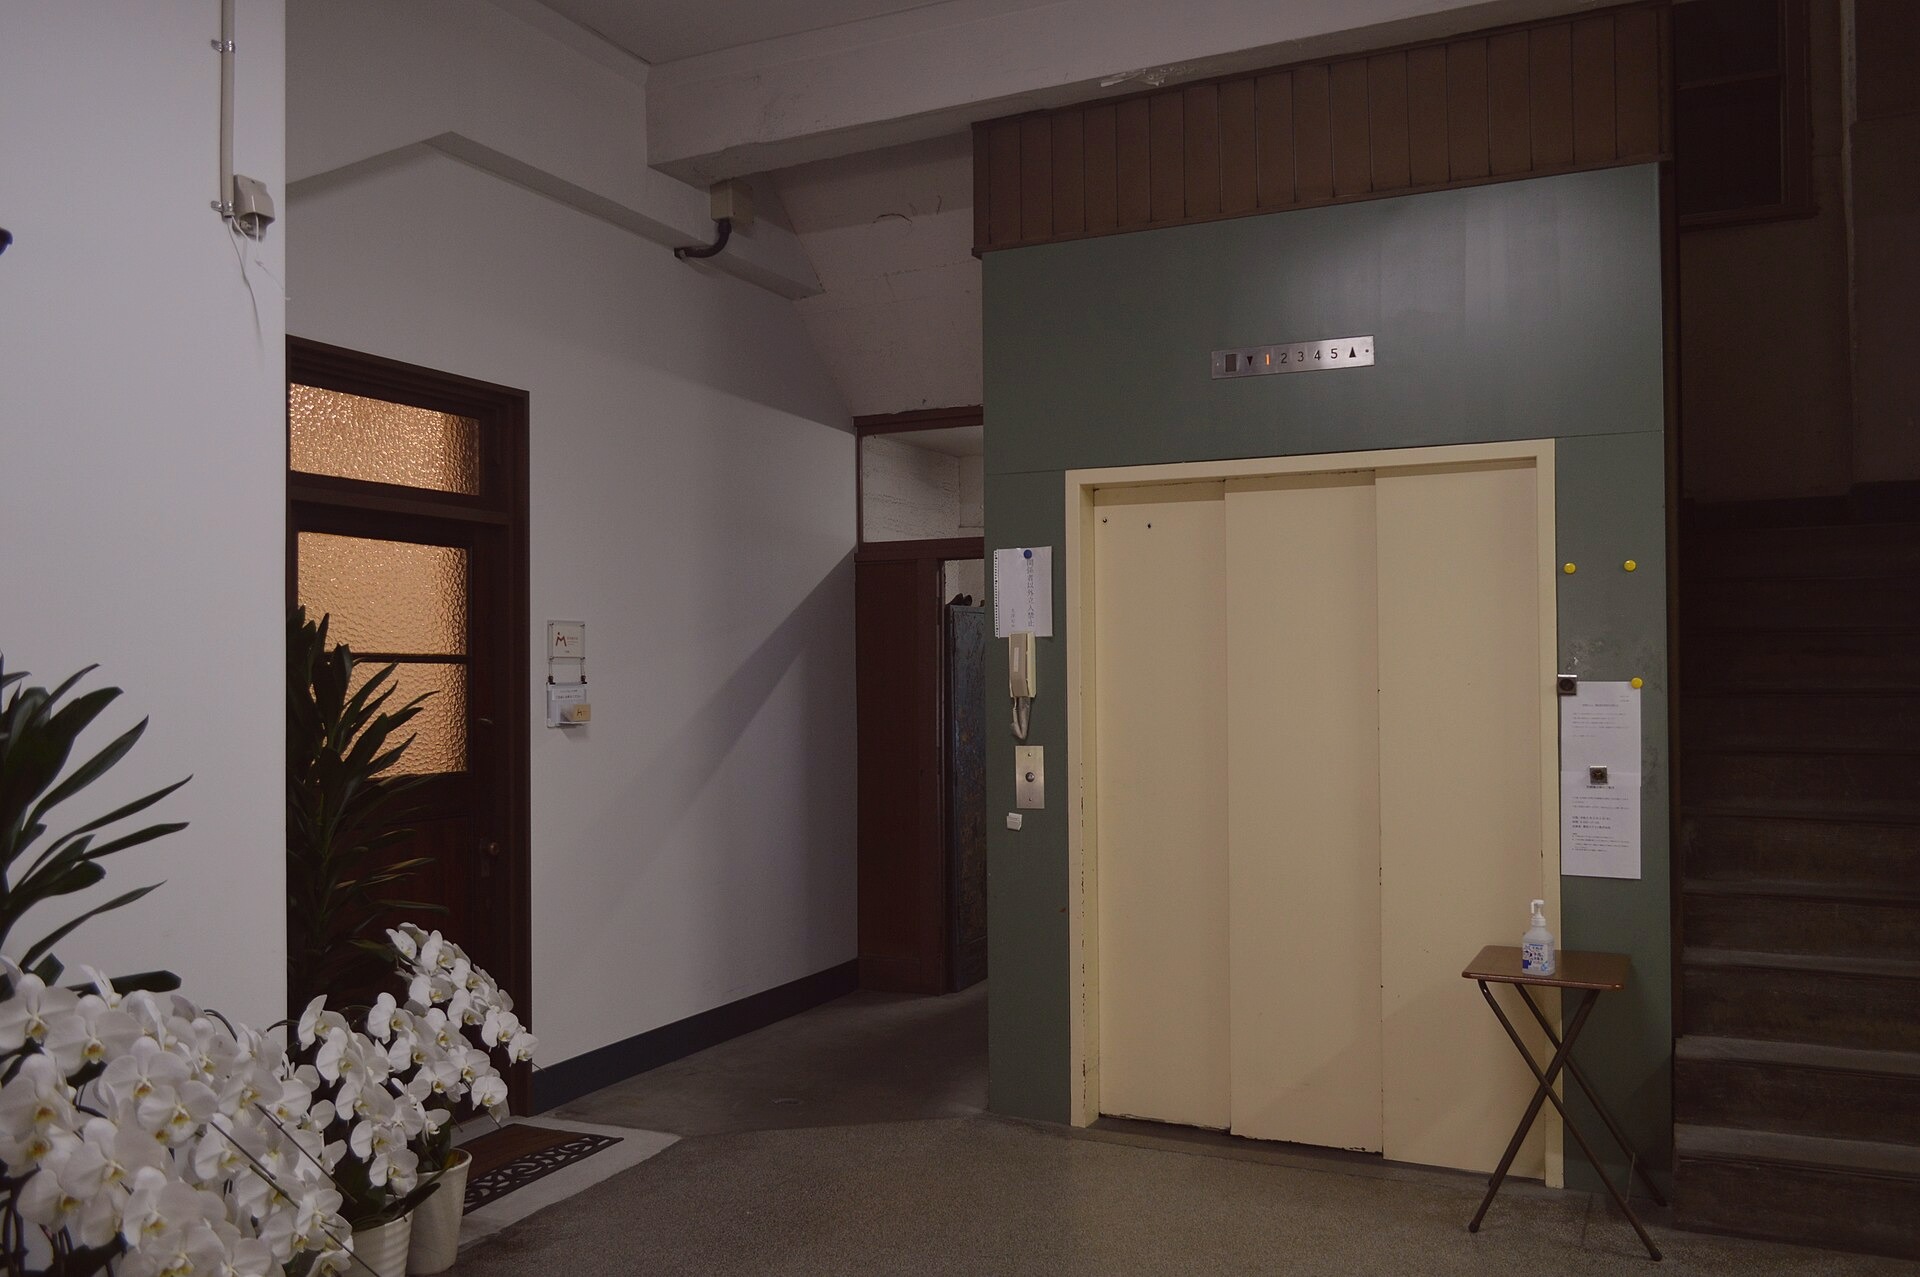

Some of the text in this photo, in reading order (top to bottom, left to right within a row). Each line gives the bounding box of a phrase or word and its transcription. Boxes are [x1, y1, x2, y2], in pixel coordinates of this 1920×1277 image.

[1265, 348, 1338, 366] 1 2 3 4 5
